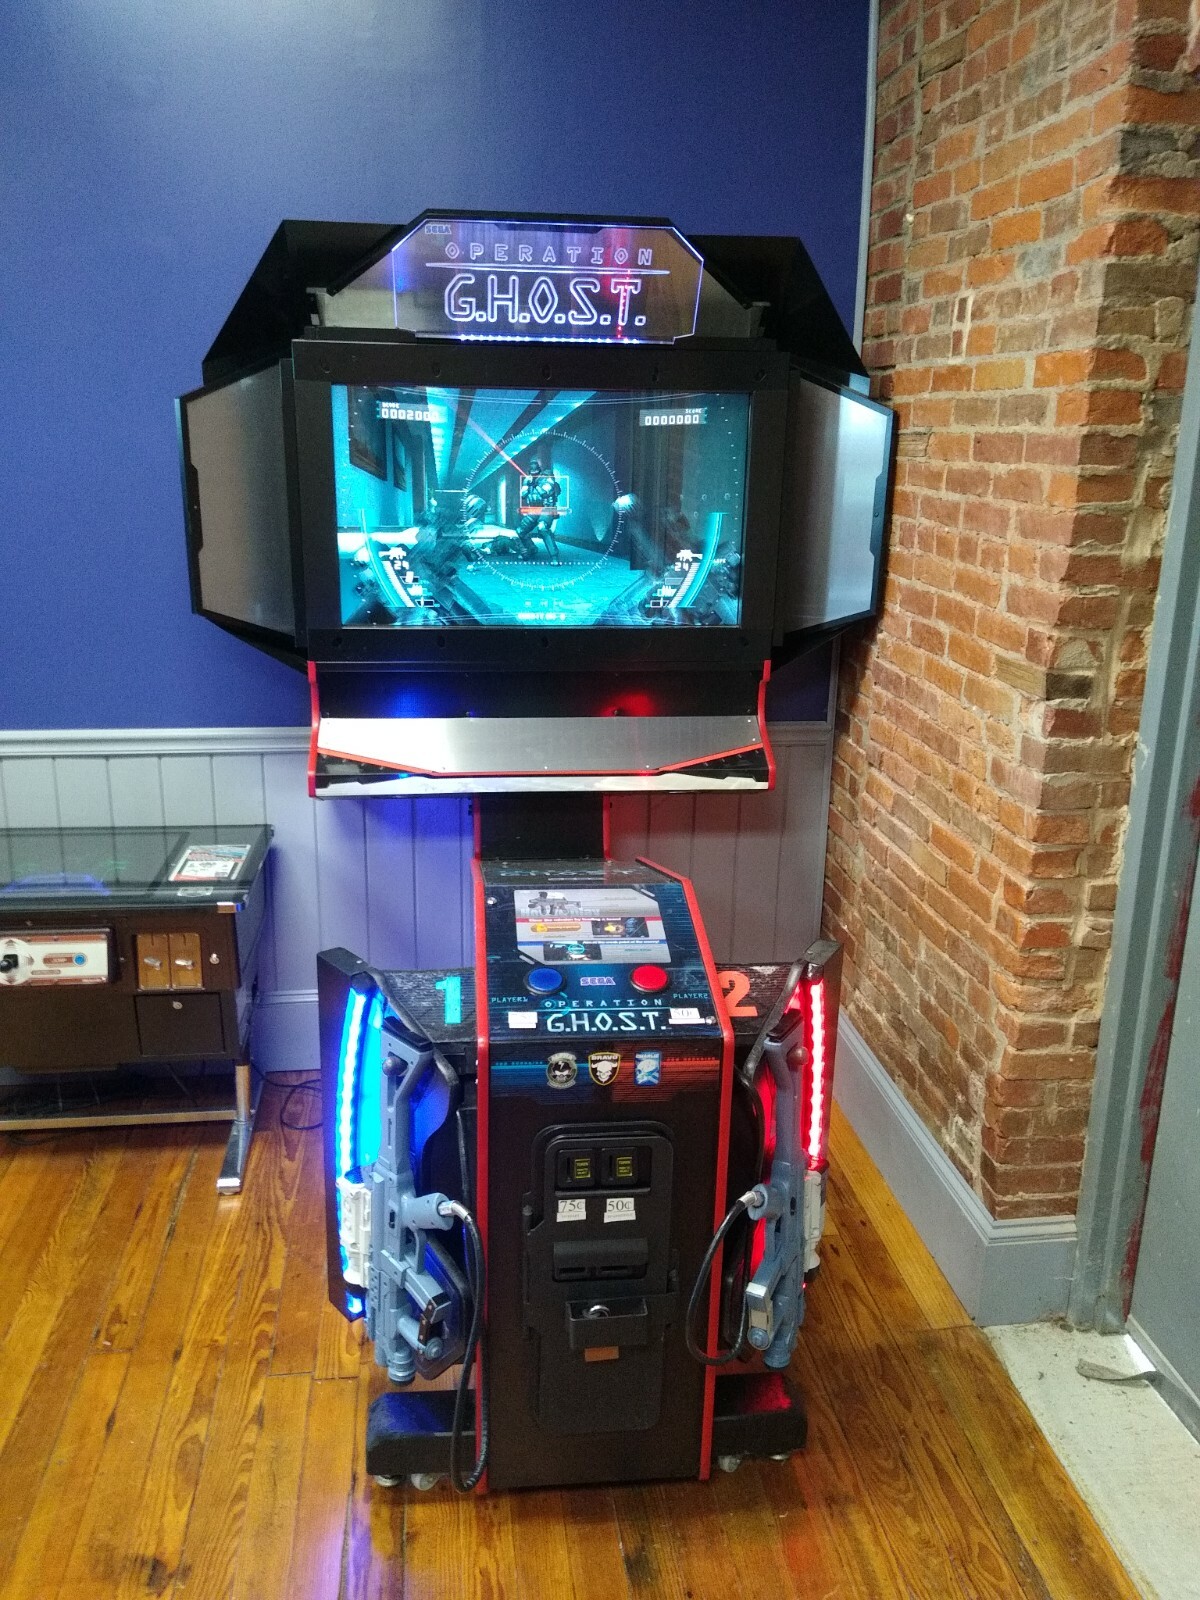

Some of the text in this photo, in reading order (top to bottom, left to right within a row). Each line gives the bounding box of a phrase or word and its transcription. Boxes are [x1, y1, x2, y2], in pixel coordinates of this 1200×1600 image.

[425, 224, 451, 234] SEGA
[445, 242, 652, 266] OPERATION
[444, 273, 647, 326] G.H.O.S.T.
[645, 414, 700, 426] 0000000
[580, 976, 616, 987] SEGA
[435, 975, 461, 1024] 1
[544, 998, 662, 1008] OPERATION
[718, 970, 758, 1017] 2
[546, 1011, 667, 1033] G.H.O.S.T.
